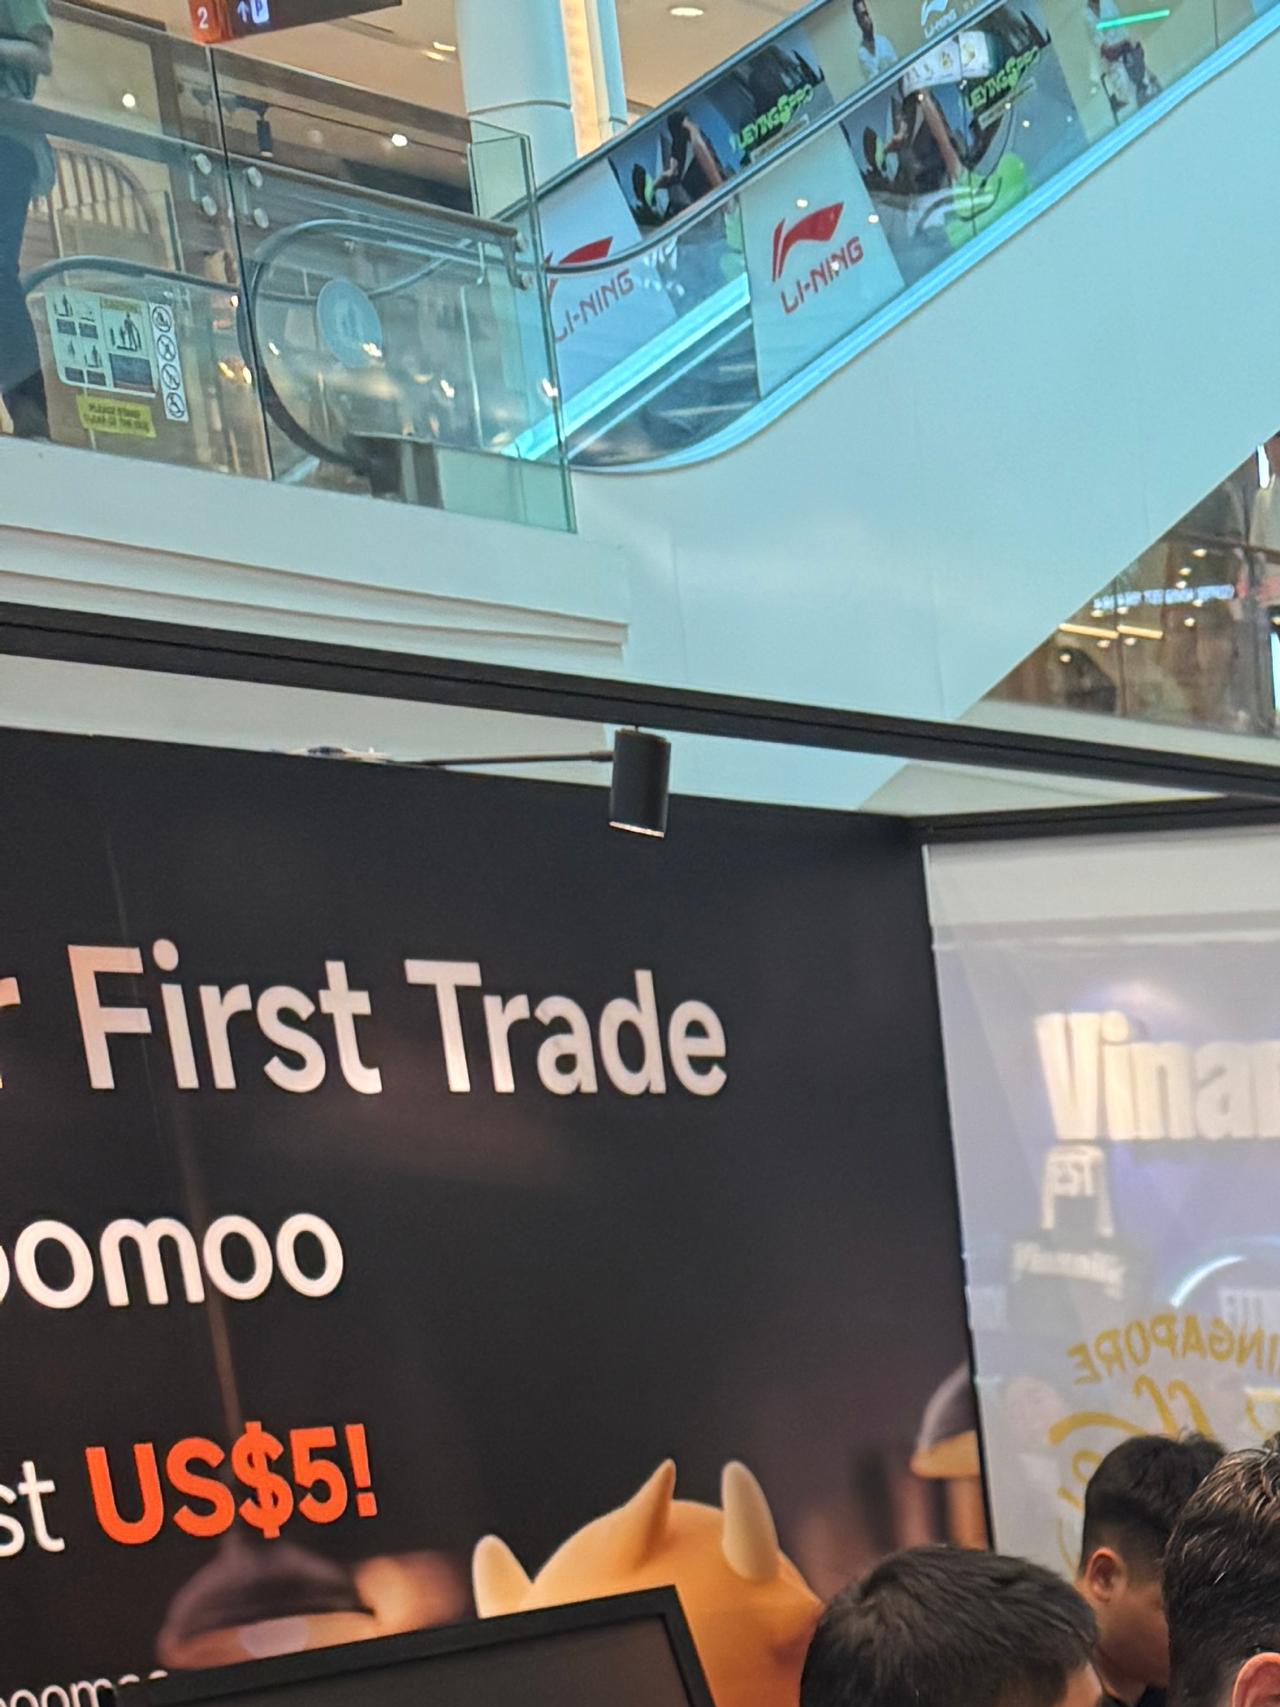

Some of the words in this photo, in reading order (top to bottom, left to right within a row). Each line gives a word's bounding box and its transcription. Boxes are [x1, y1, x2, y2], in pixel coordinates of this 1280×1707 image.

[198, 7, 209, 29] 2
[554, 269, 635, 343] LI-NING
[781, 236, 864, 314] LI-NING
[67, 937, 383, 1095] First
[404, 958, 728, 1097] Trade
[0, 1212, 344, 1311] omoo
[0, 1460, 66, 1558] st
[85, 1420, 379, 1545] US$5!
